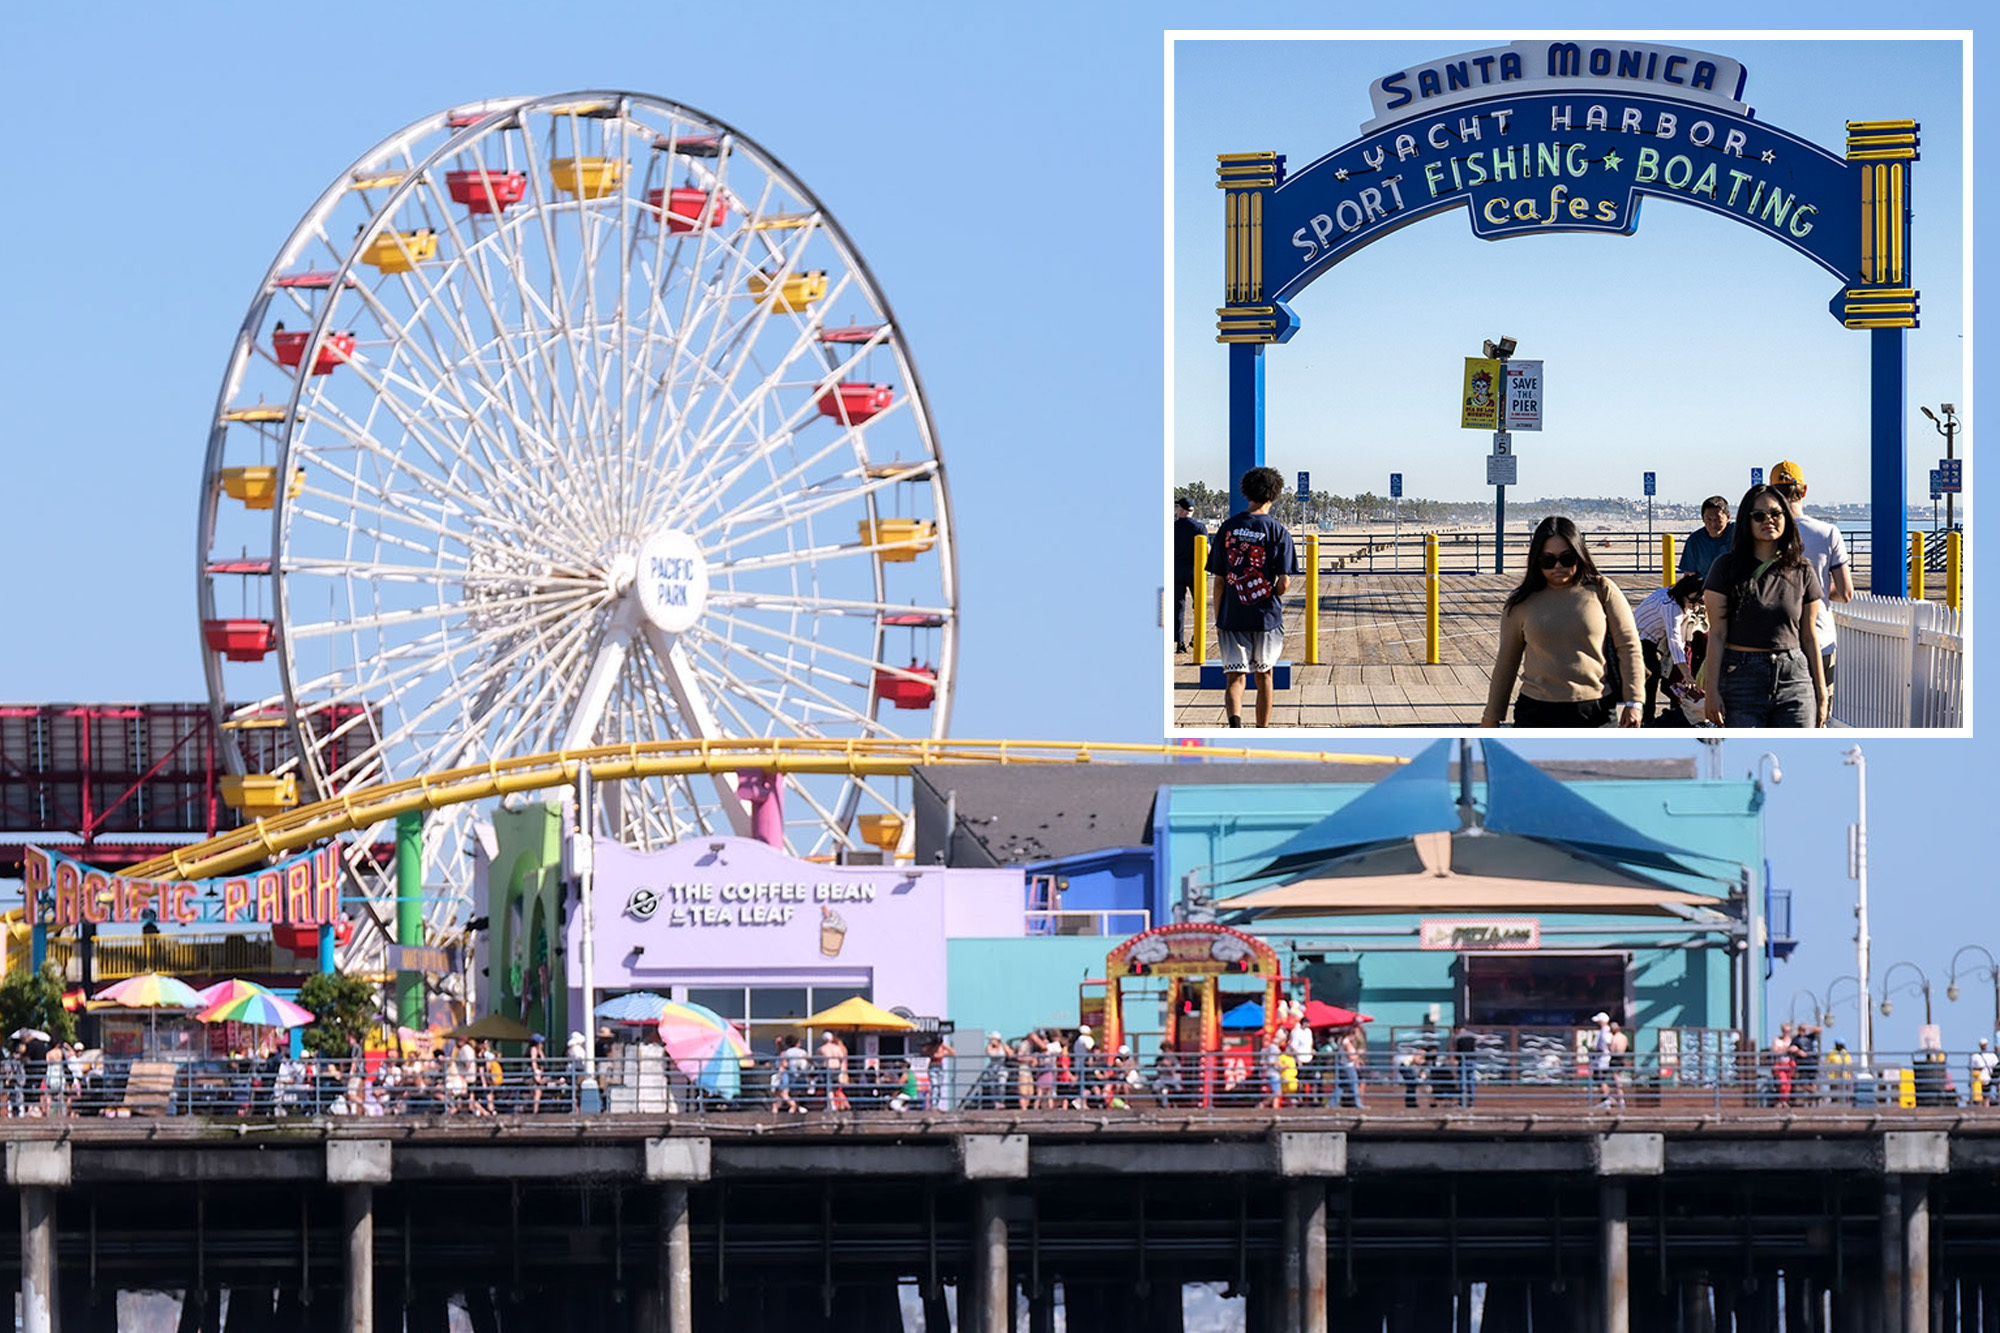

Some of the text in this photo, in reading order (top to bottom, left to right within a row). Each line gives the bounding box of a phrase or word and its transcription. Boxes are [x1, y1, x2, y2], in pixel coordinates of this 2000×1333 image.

[1381, 42, 1717, 110] SANTA MONICA
[1363, 105, 1747, 172] YACHT HARBOR
[1292, 143, 1820, 262] SPORT FISHING BOATING
[1484, 184, 1618, 225] cafes
[1512, 377, 1537, 389] SAVE
[1512, 400, 1537, 411] PIER
[1498, 442, 1506, 454] 5
[651, 556, 694, 581] PACIFIC
[658, 583, 688, 606] PARK
[25, 838, 341, 925] PACIFIC PARK
[671, 883, 876, 900] THE COFFEE BEAN
[688, 906, 731, 923] TEA
[741, 906, 795, 922] LEAF
